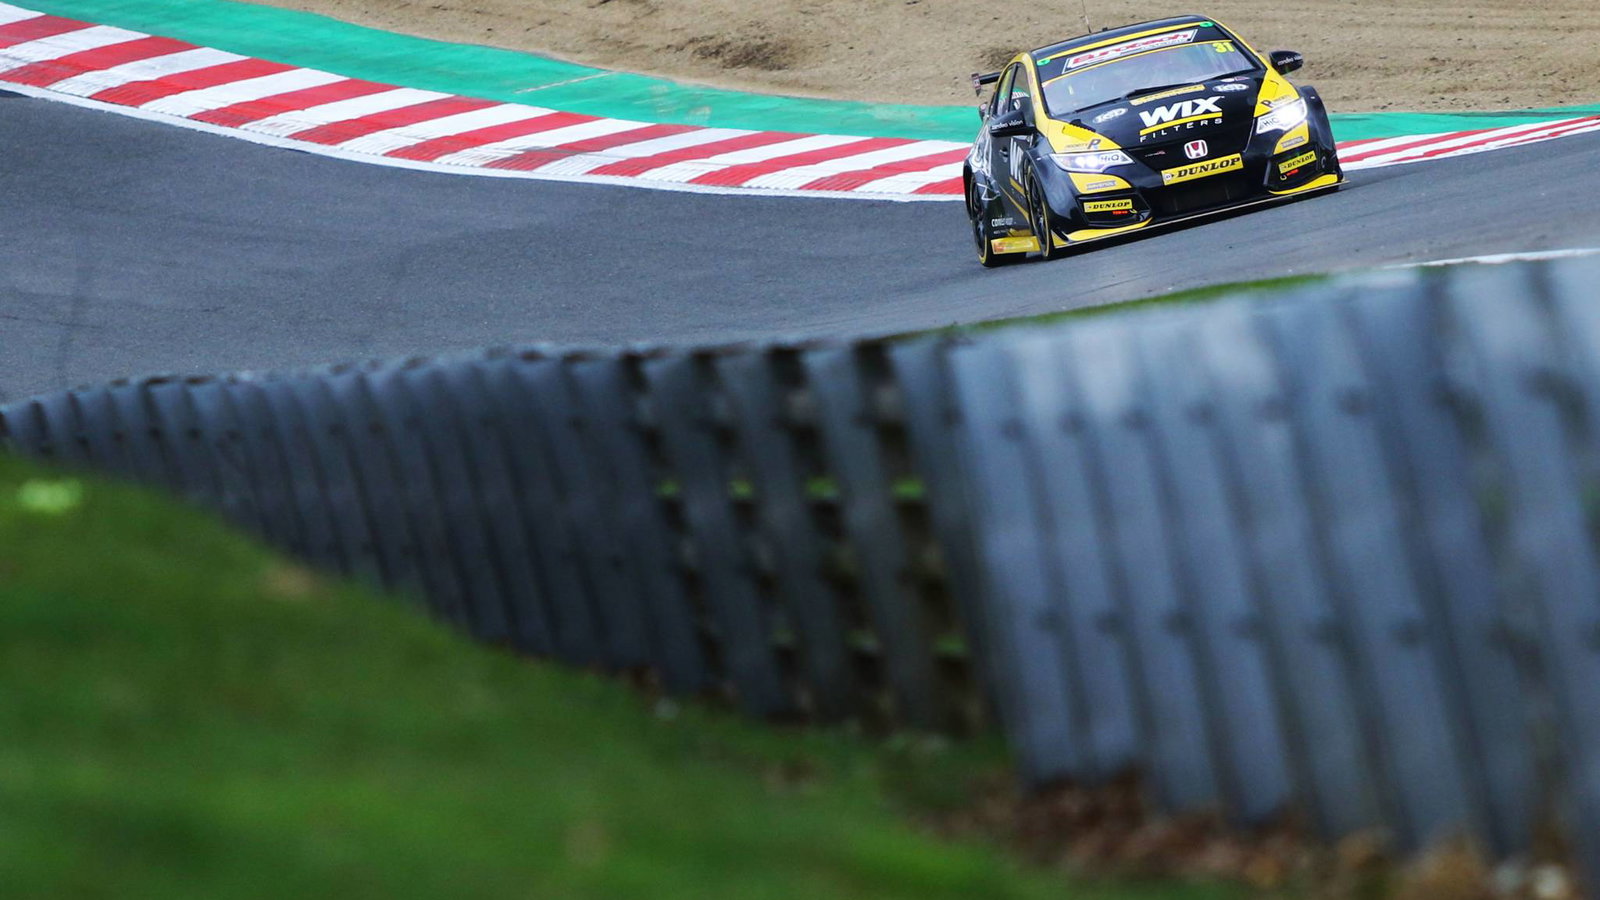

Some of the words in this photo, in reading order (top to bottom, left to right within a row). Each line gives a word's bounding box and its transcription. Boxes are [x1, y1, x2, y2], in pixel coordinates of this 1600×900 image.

[1212, 42, 1235, 53] 31
[1138, 95, 1222, 128] WIX
[1139, 117, 1223, 143] FILTERS
[1177, 156, 1241, 178] DUNLOP
[1287, 153, 1314, 169] DUNLOP
[1092, 201, 1130, 209] DUNLOP
